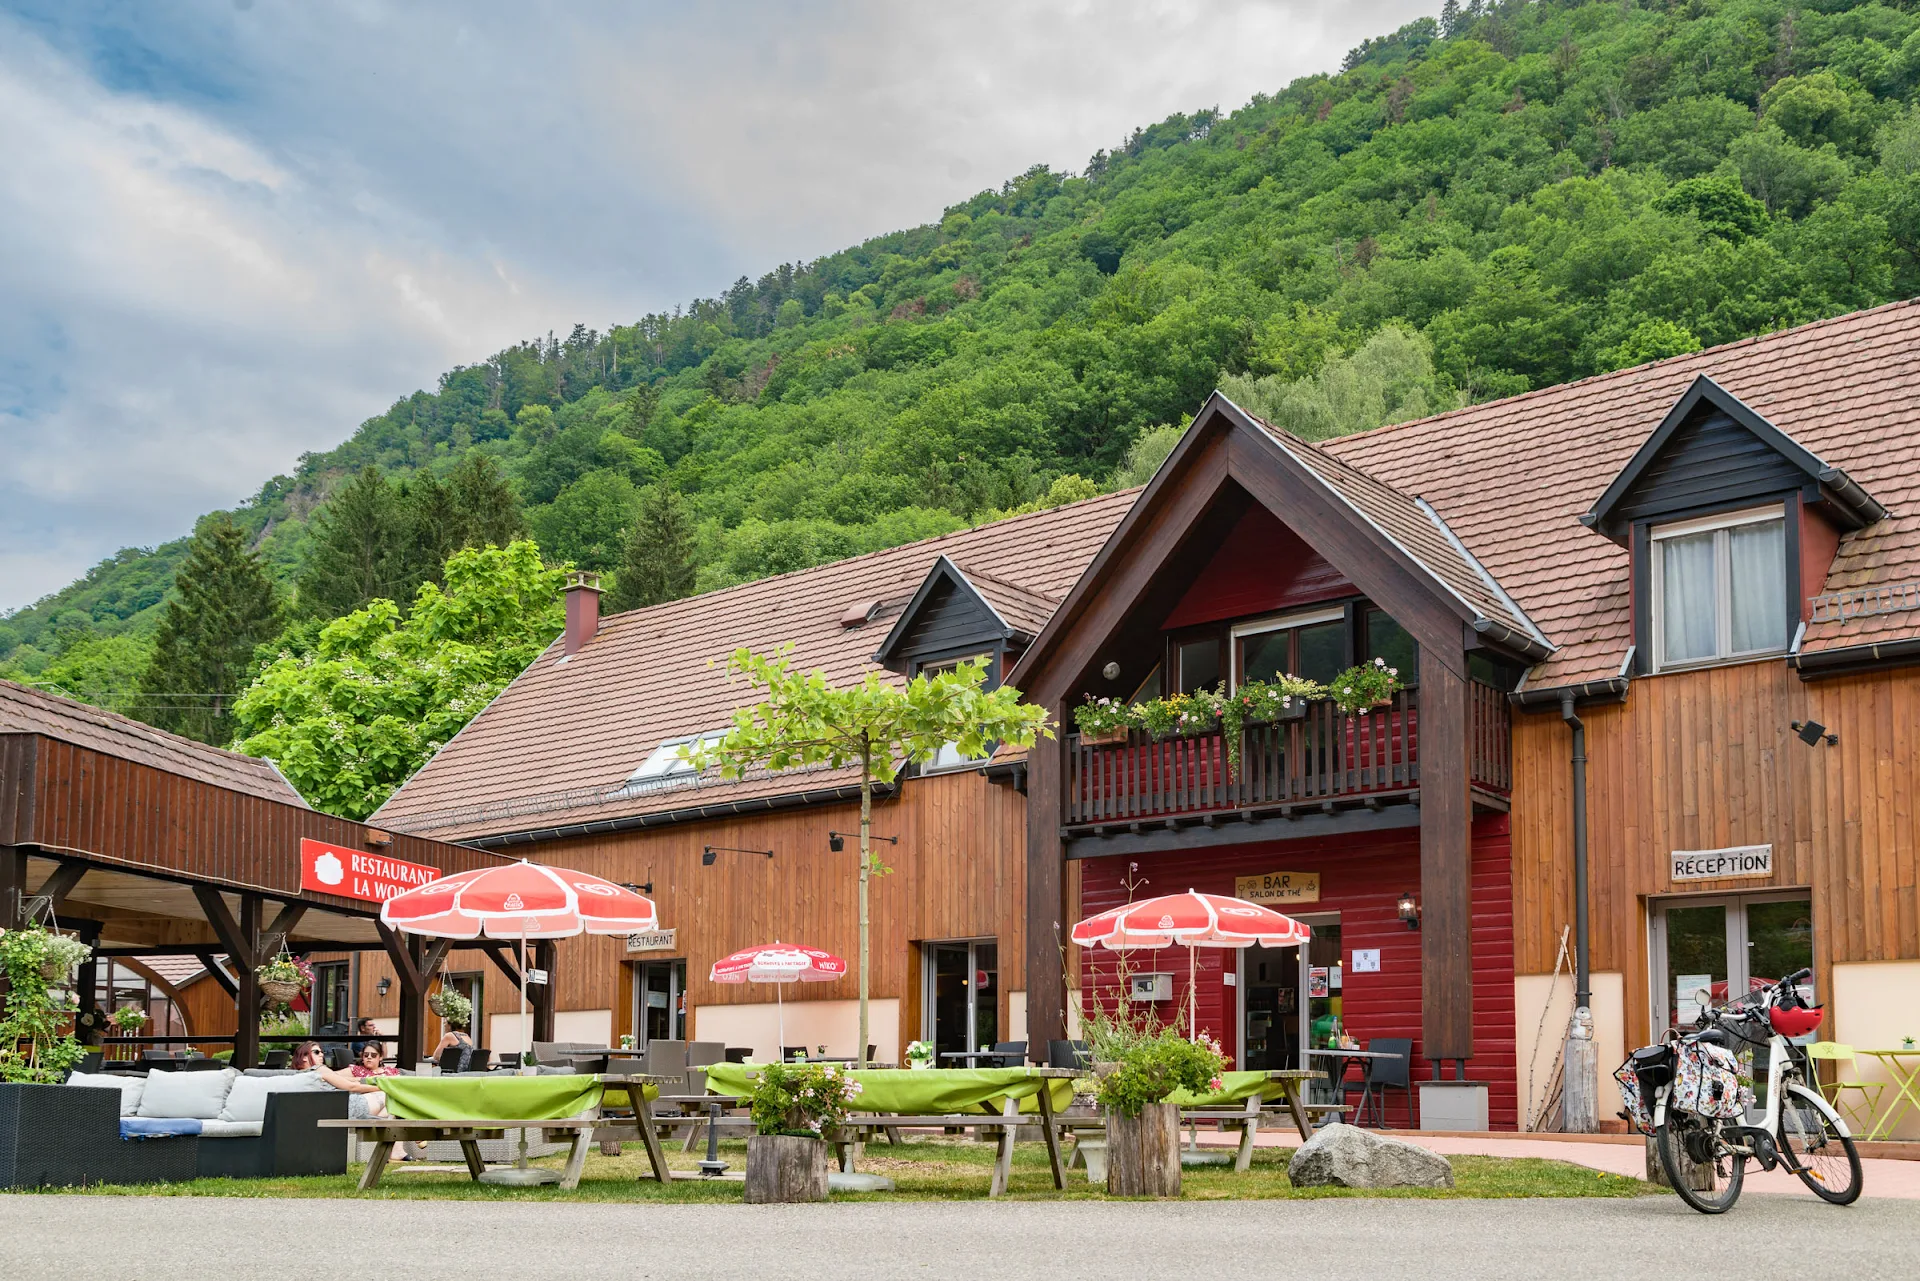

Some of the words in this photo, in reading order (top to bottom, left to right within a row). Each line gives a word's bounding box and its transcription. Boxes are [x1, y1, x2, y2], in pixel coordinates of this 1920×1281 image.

[352, 854, 434, 885] RESTAURANT
[354, 877, 370, 896] LA
[1263, 876, 1290, 889] BAR
[1250, 890, 1274, 898] SALON
[1287, 888, 1301, 897] THÉ
[628, 934, 673, 947] RESTAURANT
